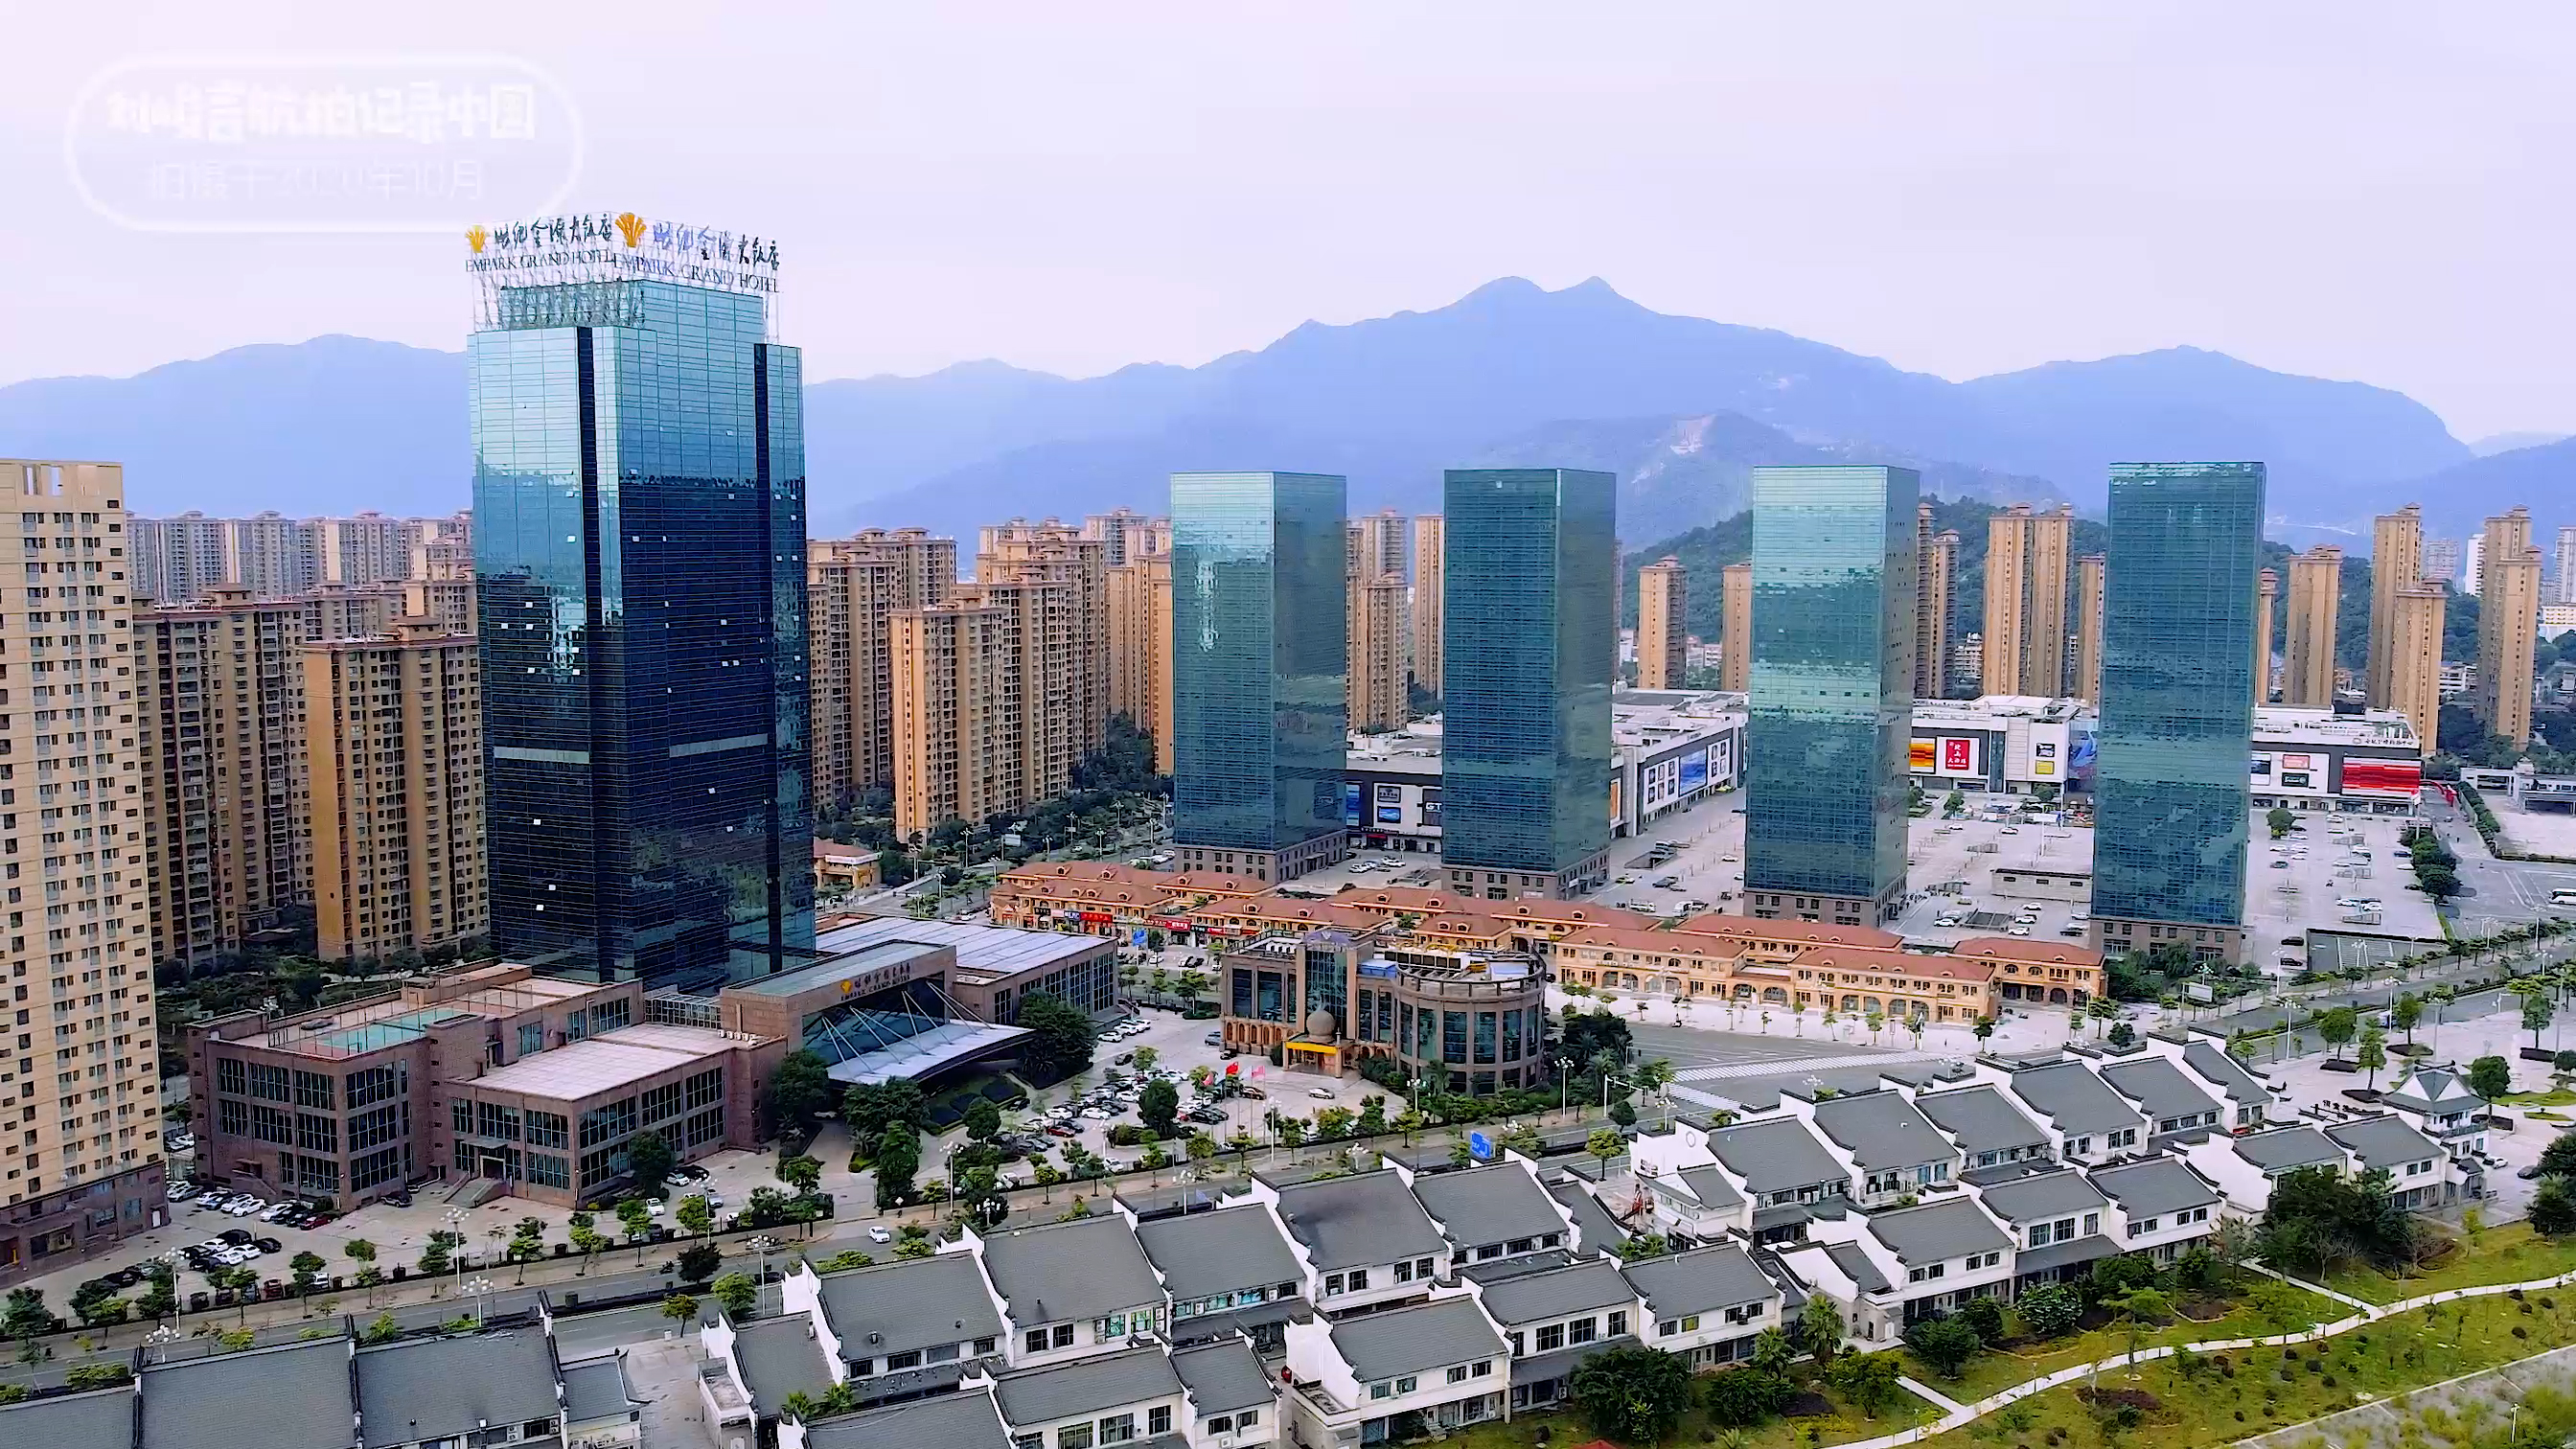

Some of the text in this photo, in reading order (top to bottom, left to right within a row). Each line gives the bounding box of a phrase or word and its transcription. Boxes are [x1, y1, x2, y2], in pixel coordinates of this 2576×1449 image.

[465, 248, 614, 272] EMPARK GRAND HOTEL
[613, 252, 780, 294] EMPARK GRAND HOTEL
